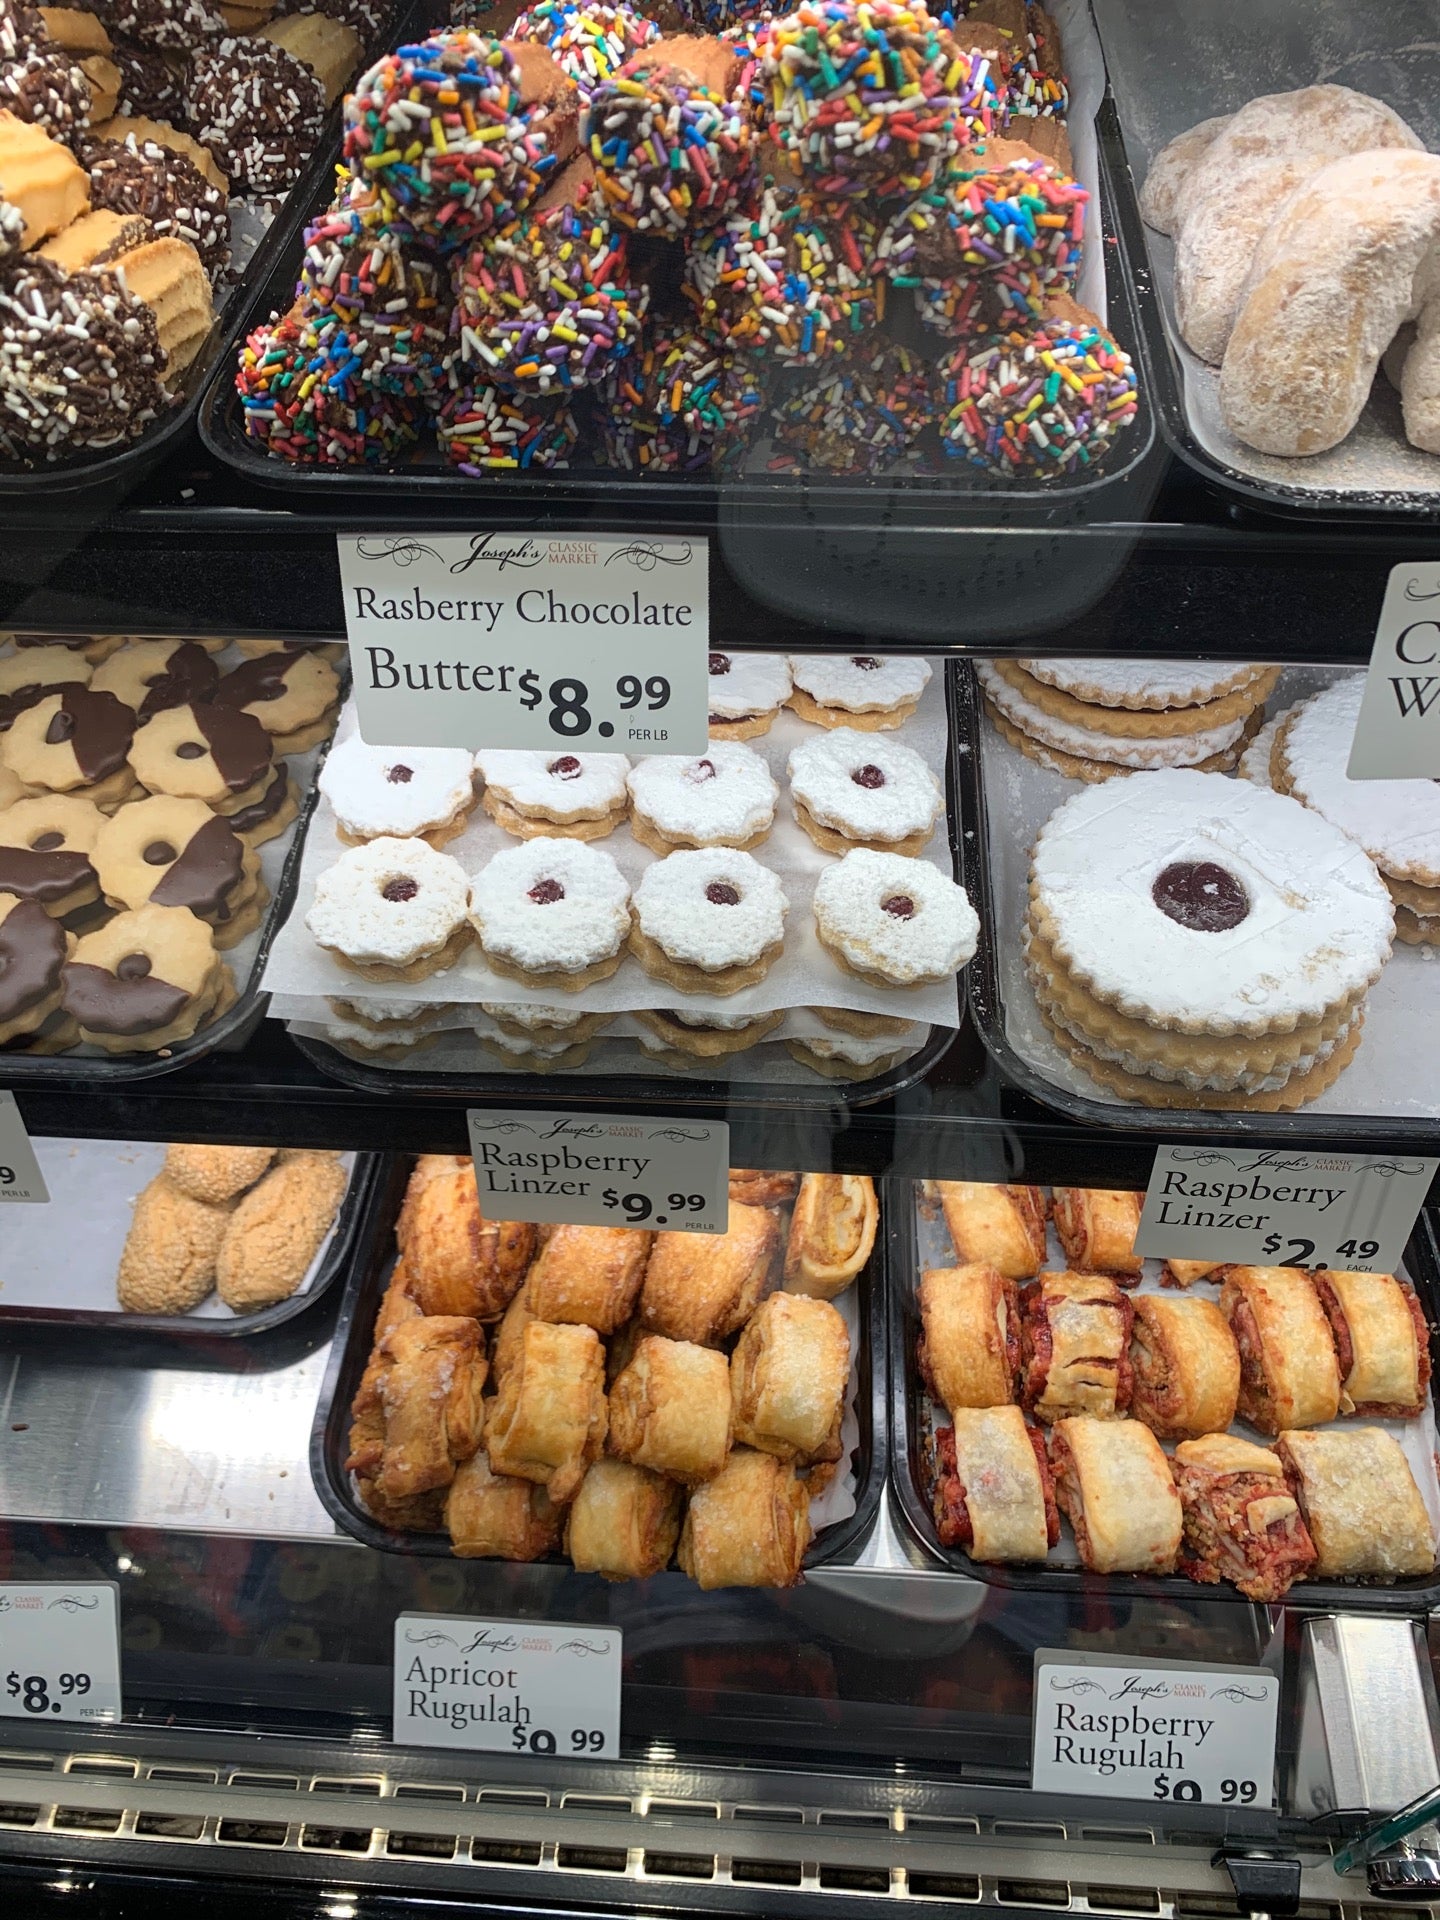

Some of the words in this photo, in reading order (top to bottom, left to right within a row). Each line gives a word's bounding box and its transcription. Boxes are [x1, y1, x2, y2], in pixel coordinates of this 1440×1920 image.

[450, 532, 548, 574] Joseph's
[548, 542, 597, 553] CLASSIC
[548, 553, 598, 564] MARKET
[353, 587, 504, 632] Rasberry
[516, 589, 692, 626] Chocolate
[1395, 620, 1440, 665] C
[365, 647, 515, 692] Butter
[1387, 676, 1440, 717] W
[628, 728, 651, 740] PER
[653, 729, 668, 741] LB
[539, 1119, 607, 1140] Joseph's
[608, 1131, 643, 1139] MARKET
[479, 1142, 651, 1179] Raspberry
[1237, 1151, 1315, 1172] Joseph's
[1314, 1164, 1352, 1172] MARKET
[1316, 1158, 1353, 1166] CLASSIC
[484, 1170, 591, 1196] Linzer
[1159, 1171, 1346, 1211] Raspberry
[1155, 1201, 1270, 1230] Linzer
[1346, 1264, 1372, 1272] EACH
[404, 1656, 518, 1693] Apricot
[1174, 1683, 1206, 1691] CLASSIC
[1109, 1675, 1174, 1700] Joseph's
[1174, 1690, 1206, 1698] MARKET
[80, 1708, 94, 1716] PER
[408, 1690, 532, 1729] Rugulah
[1054, 1703, 1214, 1746] Raspberry
[1052, 1736, 1184, 1775] Rugulah
